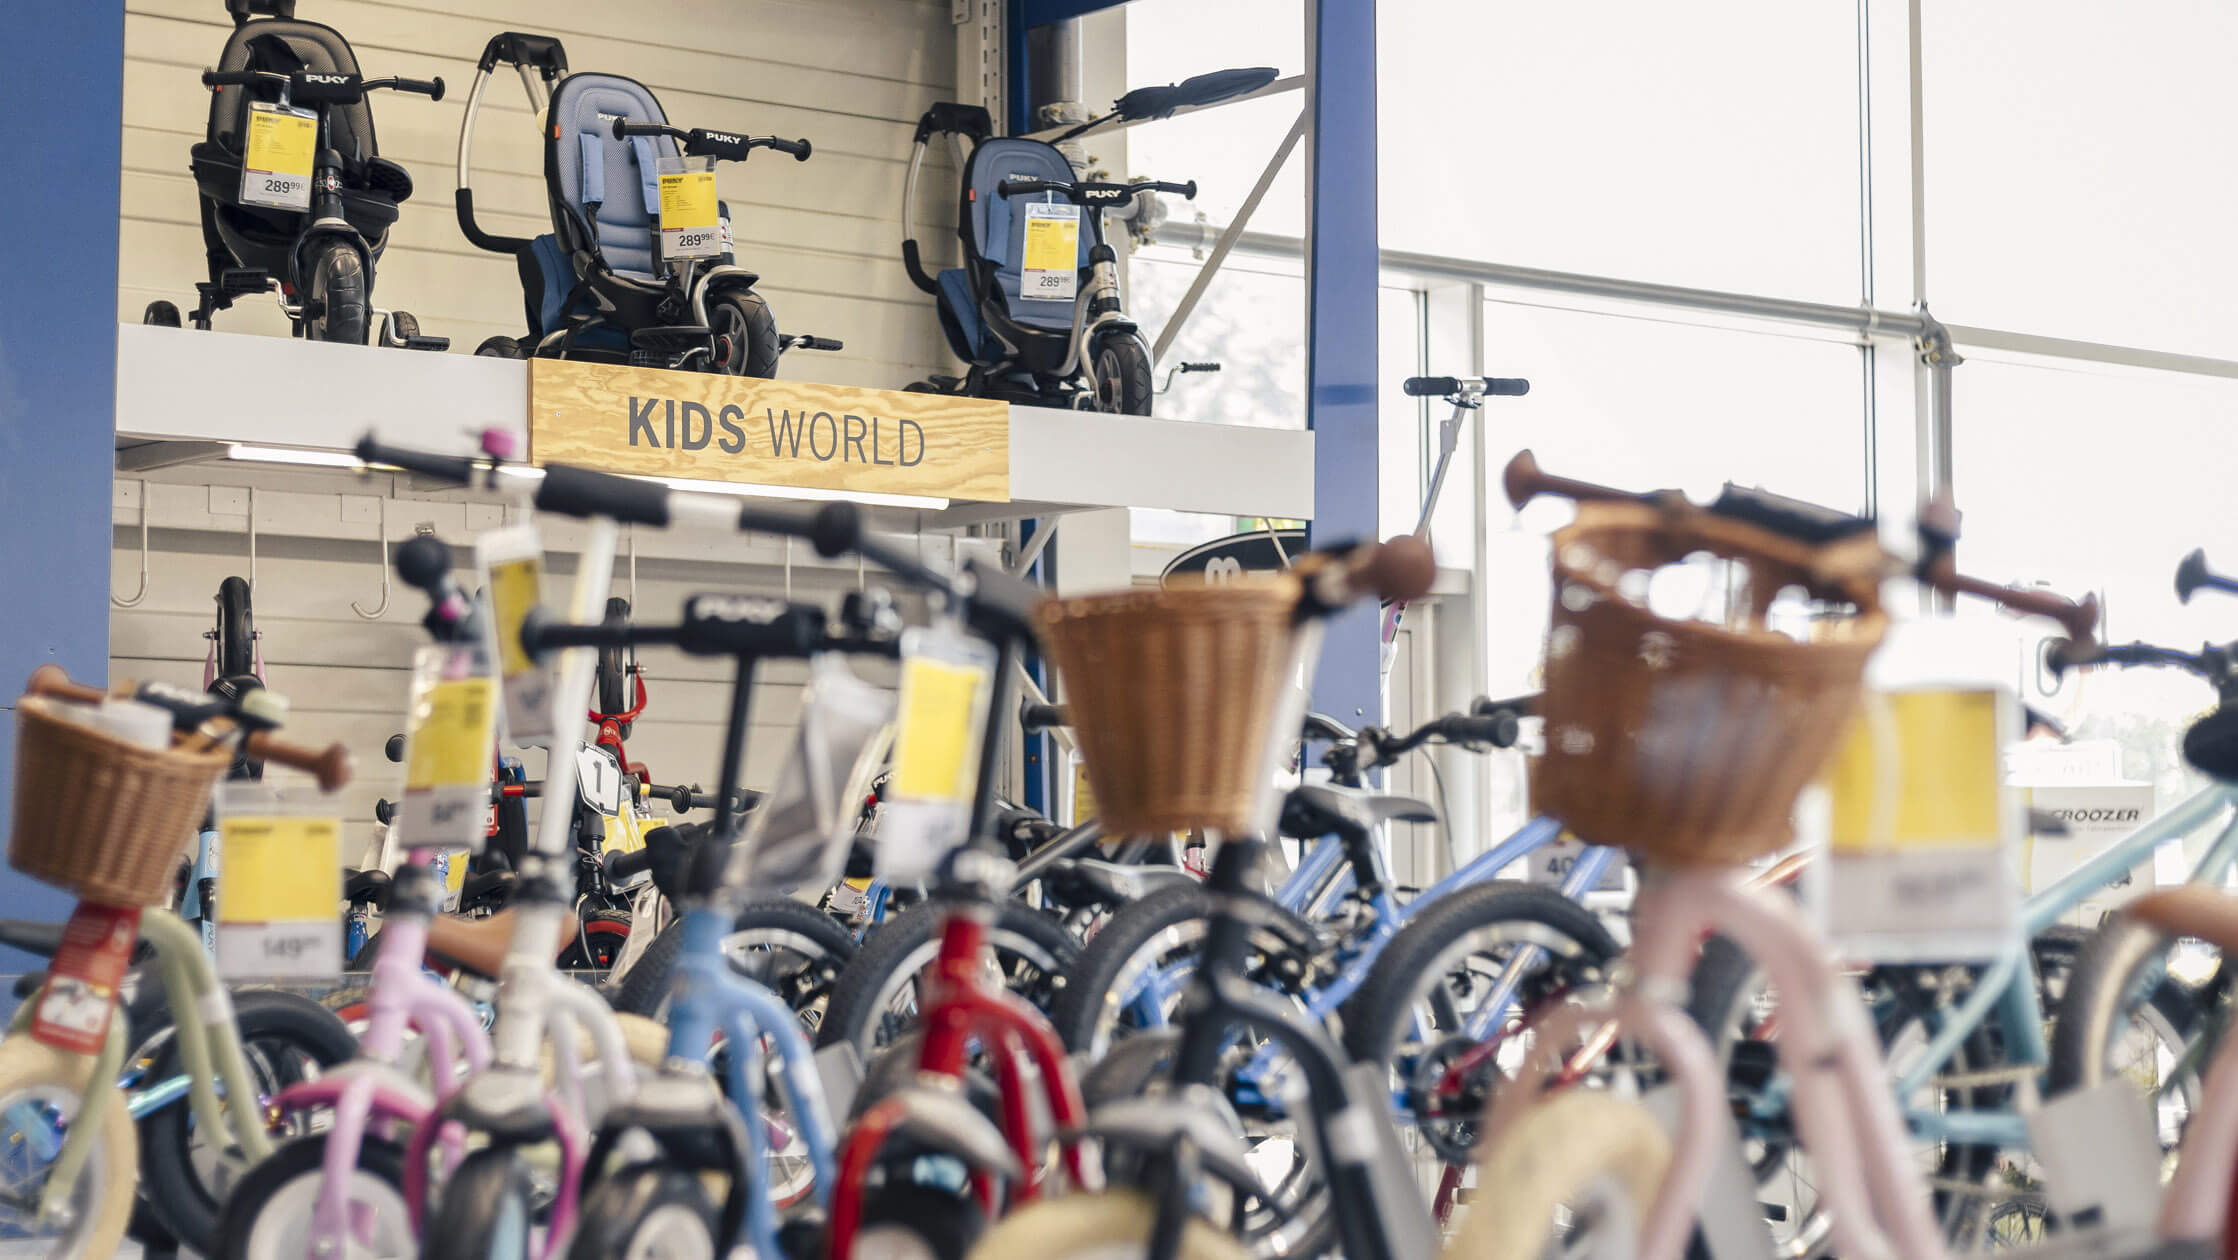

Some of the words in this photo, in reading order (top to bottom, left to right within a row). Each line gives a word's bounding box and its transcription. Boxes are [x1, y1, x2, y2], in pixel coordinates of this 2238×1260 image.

[305, 74, 350, 84] PUKY
[706, 132, 741, 145] PUKY
[1009, 173, 1039, 182] PUKY
[1085, 190, 1122, 199] PUKY
[629, 397, 746, 454] KIDS
[767, 408, 924, 467] WORLD
[593, 760, 602, 793] 1
